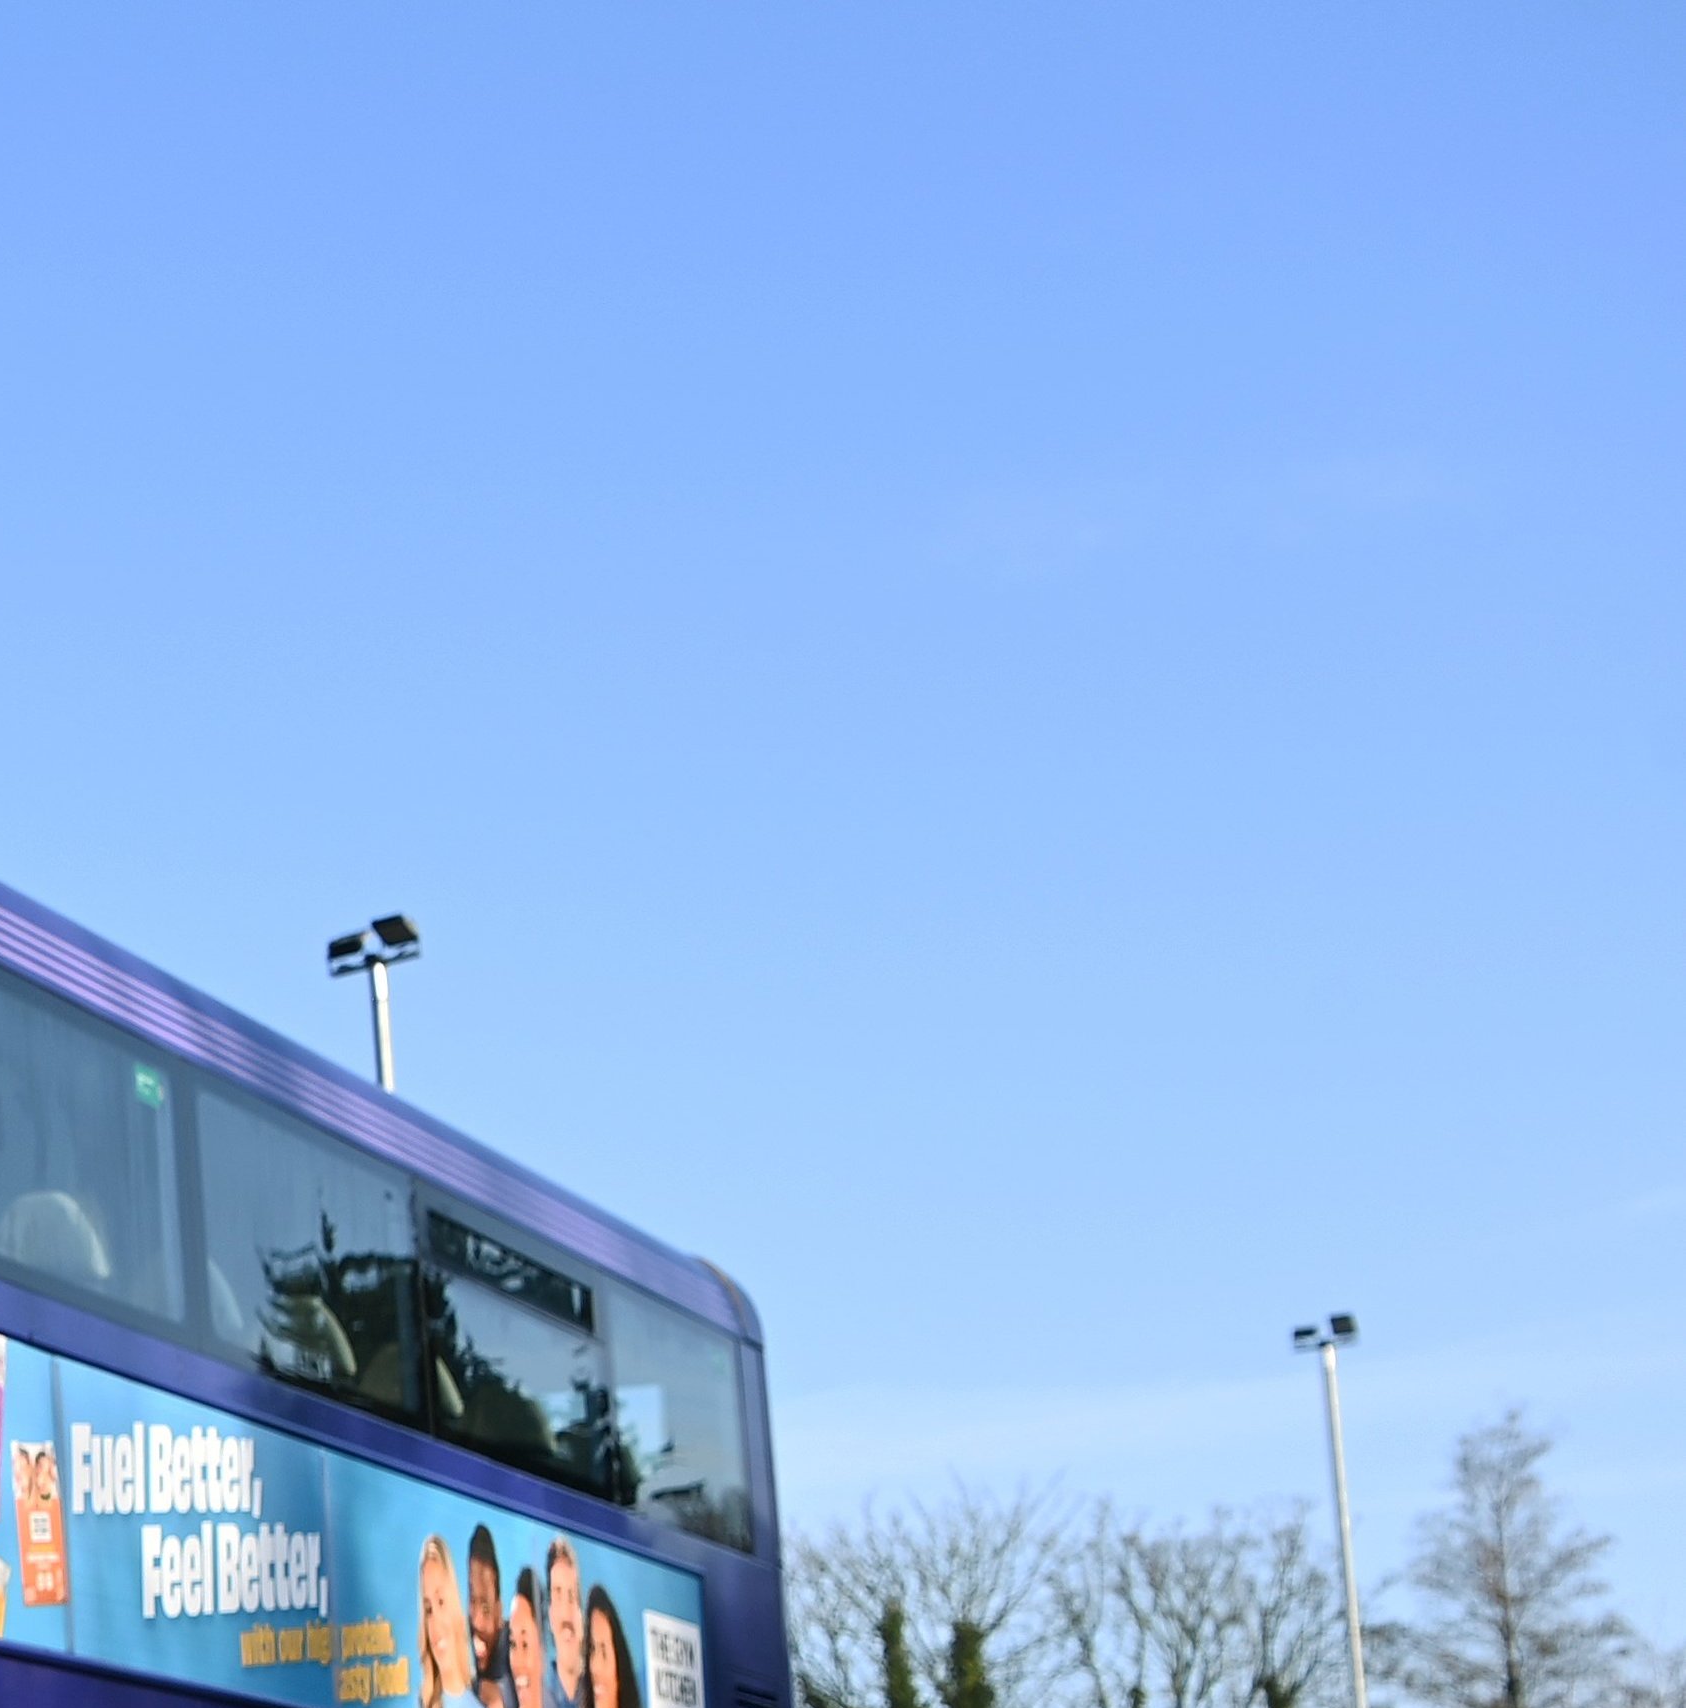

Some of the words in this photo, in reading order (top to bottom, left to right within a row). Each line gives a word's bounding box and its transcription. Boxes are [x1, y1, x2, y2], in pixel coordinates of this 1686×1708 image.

[71, 1421, 146, 1515] Fuel
[148, 1423, 263, 1519] Better,
[141, 1520, 214, 1619] Feel
[216, 1521, 328, 1618] Better,
